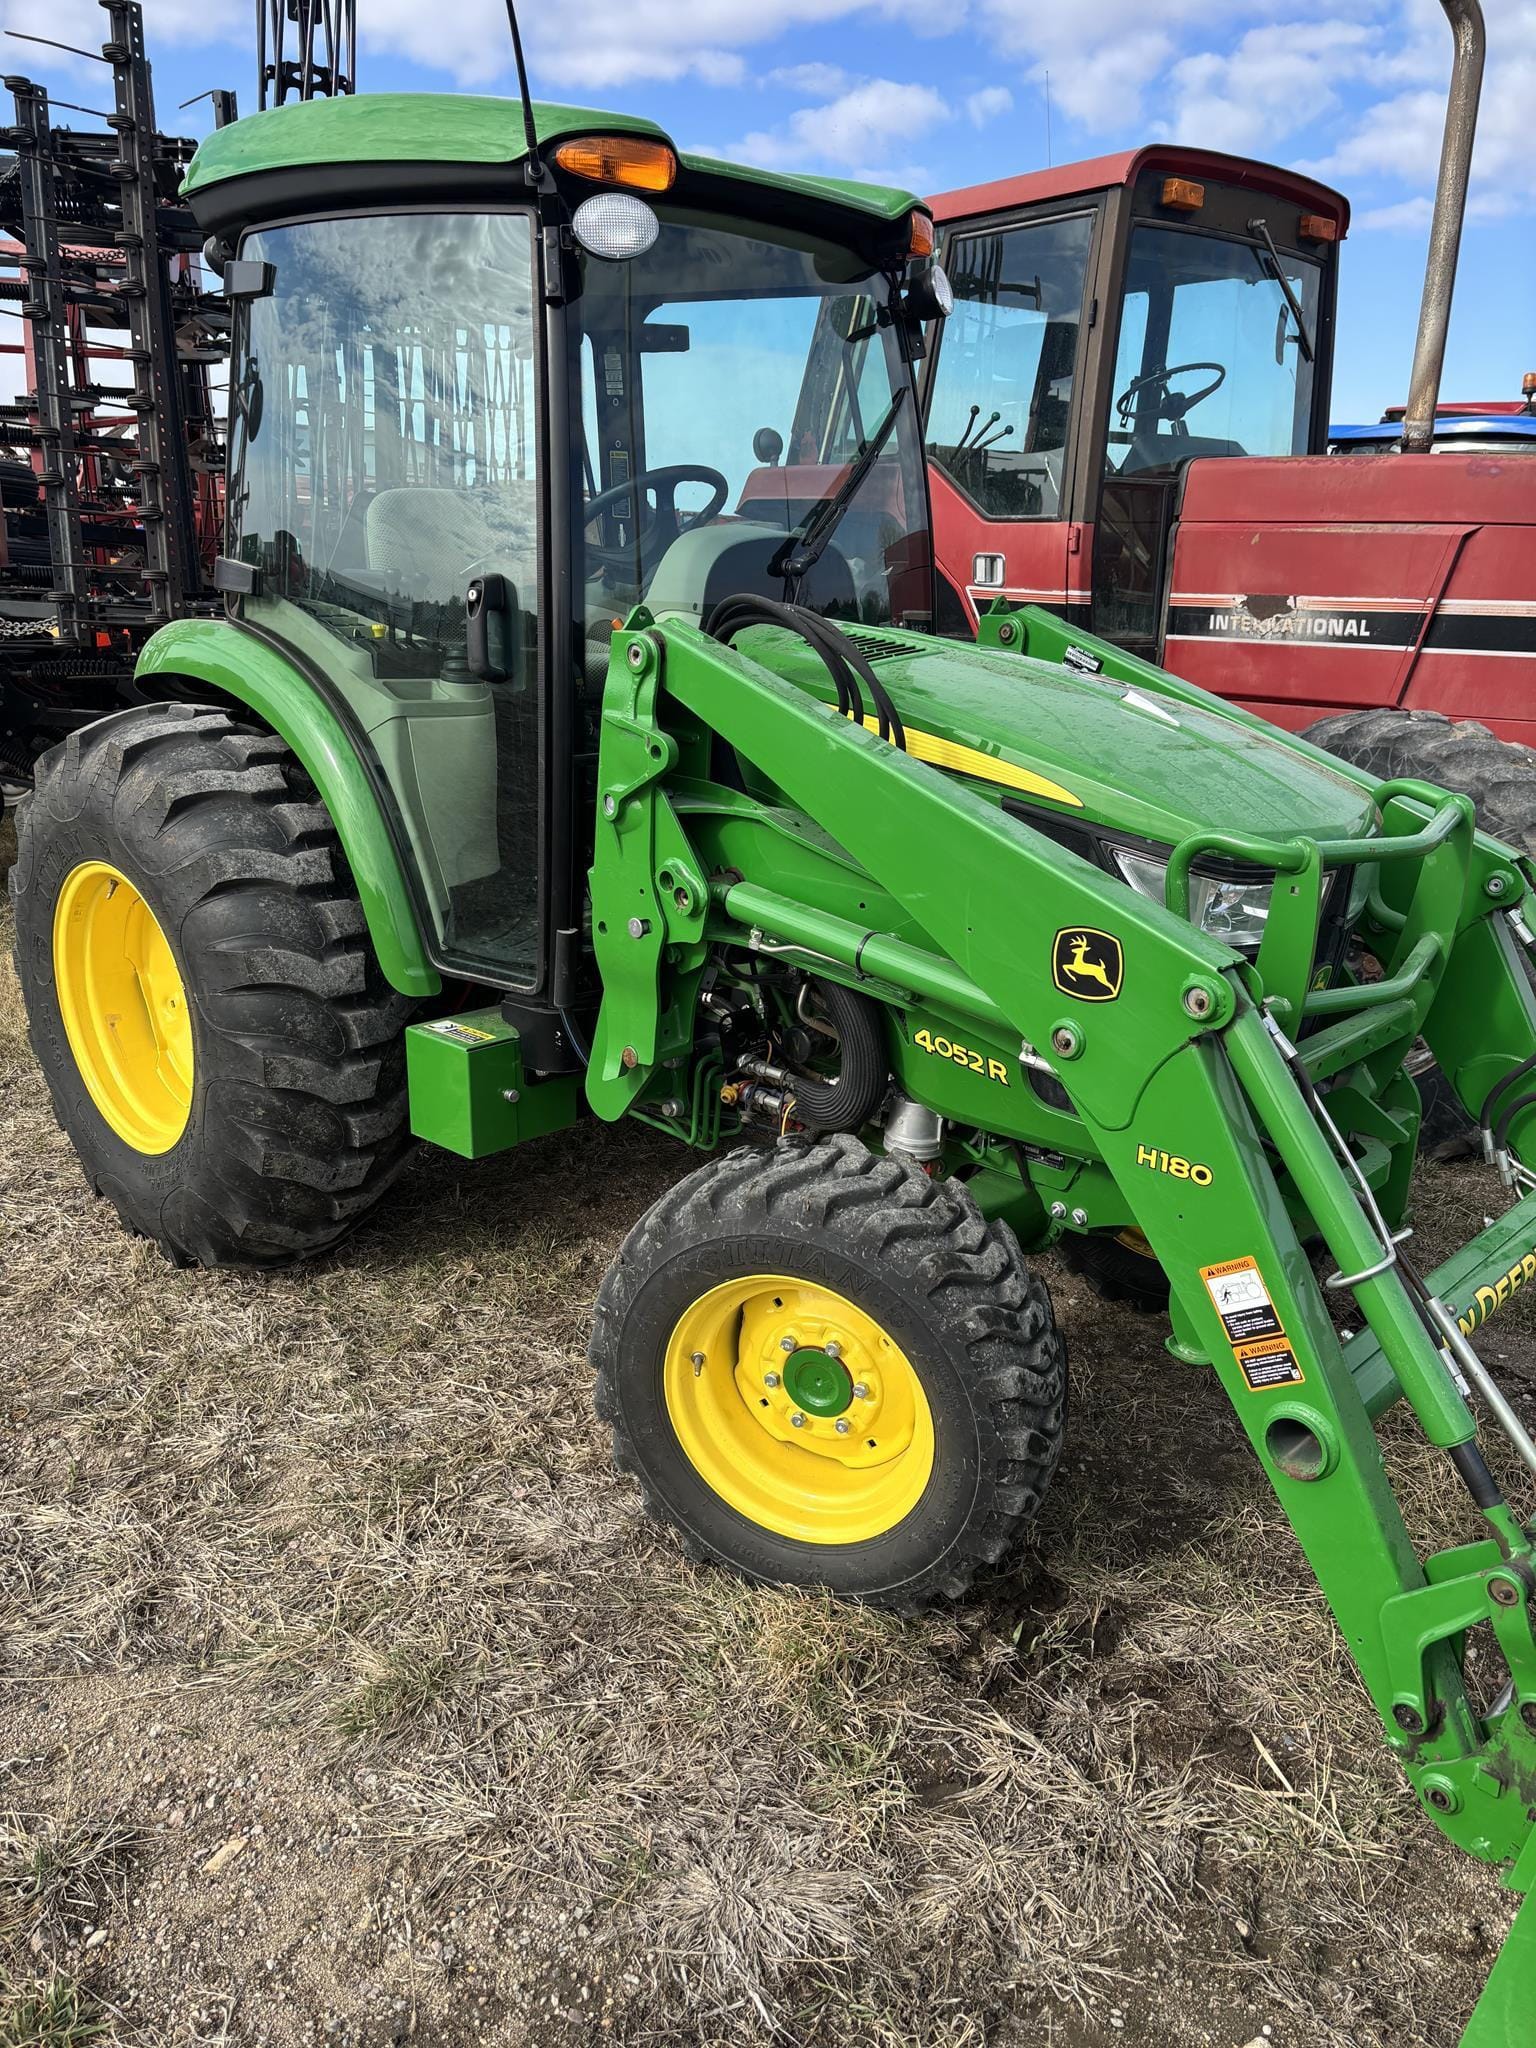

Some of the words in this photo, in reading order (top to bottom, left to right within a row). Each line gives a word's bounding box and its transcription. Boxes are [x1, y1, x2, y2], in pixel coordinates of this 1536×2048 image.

[914, 1028, 1010, 1086] 4052R
[1137, 1144, 1213, 1186] H180
[1214, 1260, 1250, 1275] WARNING
[1474, 1247, 1536, 1325] DEER
[1248, 1342, 1285, 1355] WARNING
